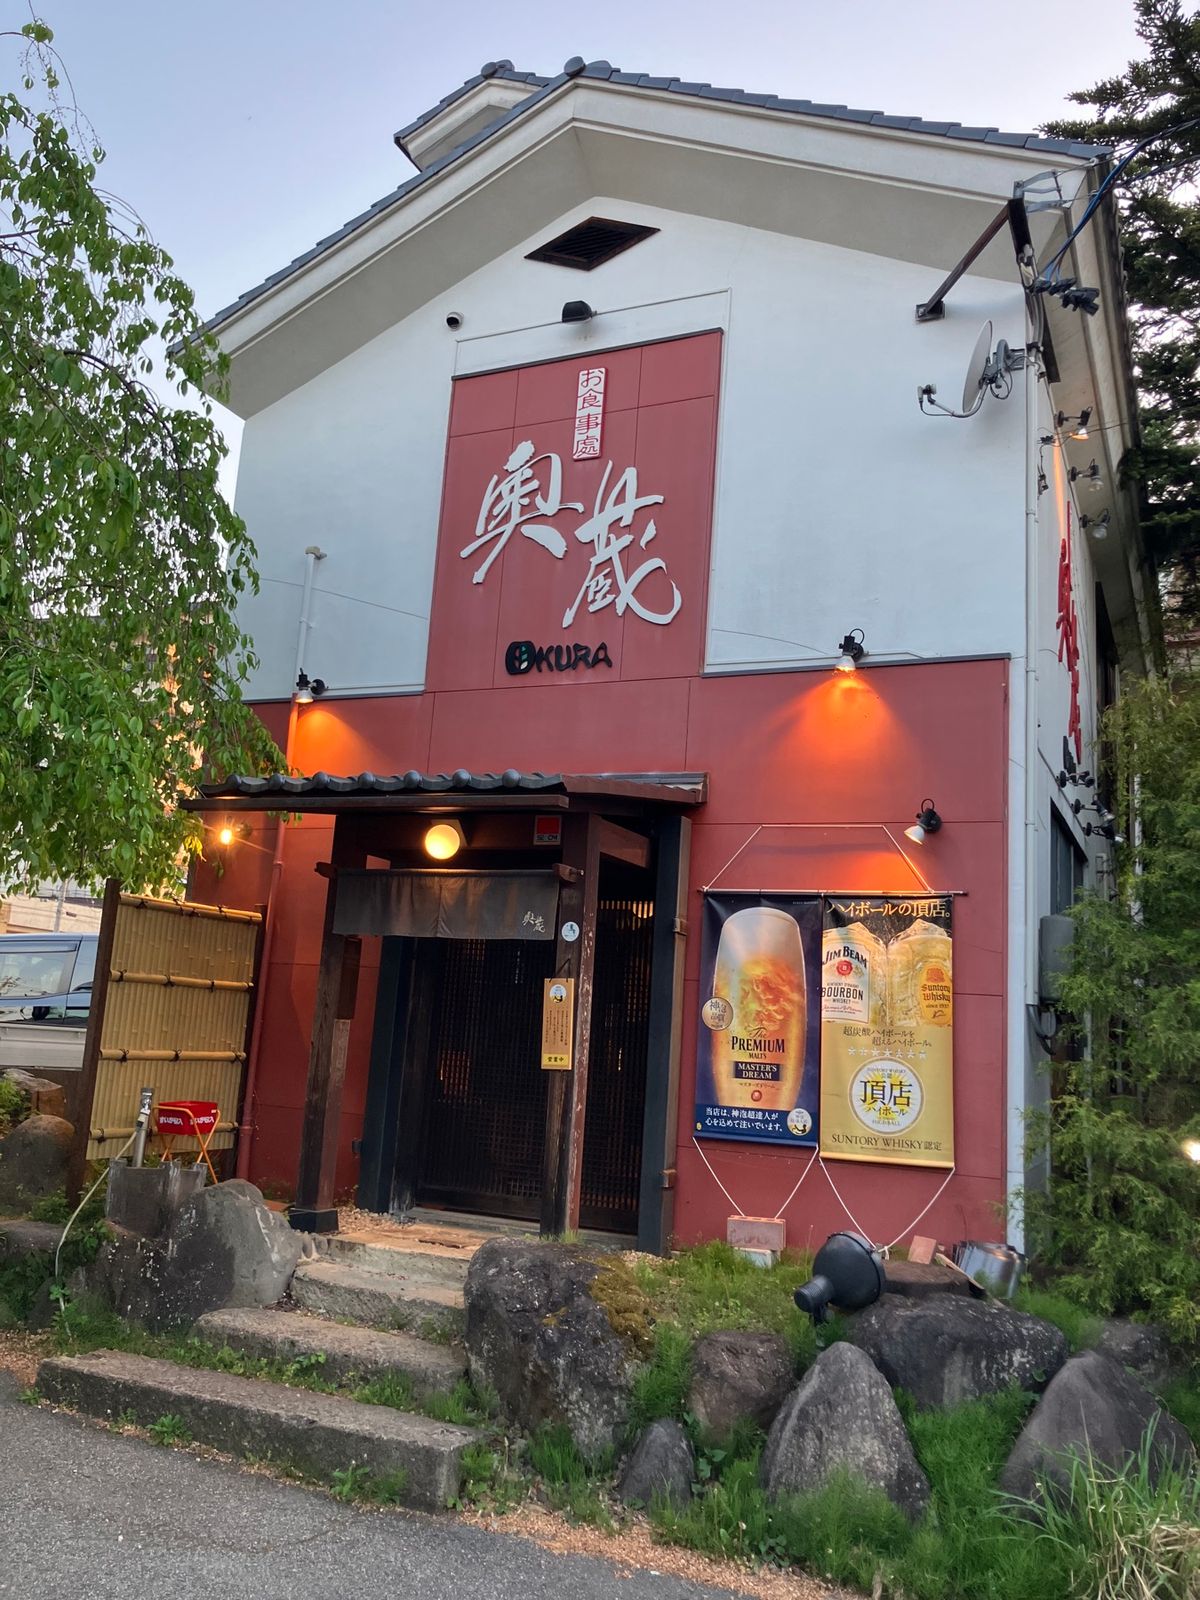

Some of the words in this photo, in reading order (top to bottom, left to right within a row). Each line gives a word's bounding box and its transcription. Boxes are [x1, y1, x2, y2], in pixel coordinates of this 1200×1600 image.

[573, 369, 604, 459] お食事處
[826, 899, 950, 918] ハイボールの頂店。
[823, 949, 841, 965] JIM
[843, 946, 867, 968] BEAM
[822, 986, 864, 1001] BOURBON
[731, 1036, 785, 1053] PREMIUM
[742, 1070, 772, 1080] DREAM
[859, 1080, 913, 1107] 頂店
[831, 1134, 880, 1146] SUNTORY
[882, 1137, 923, 1149] WHISKY
